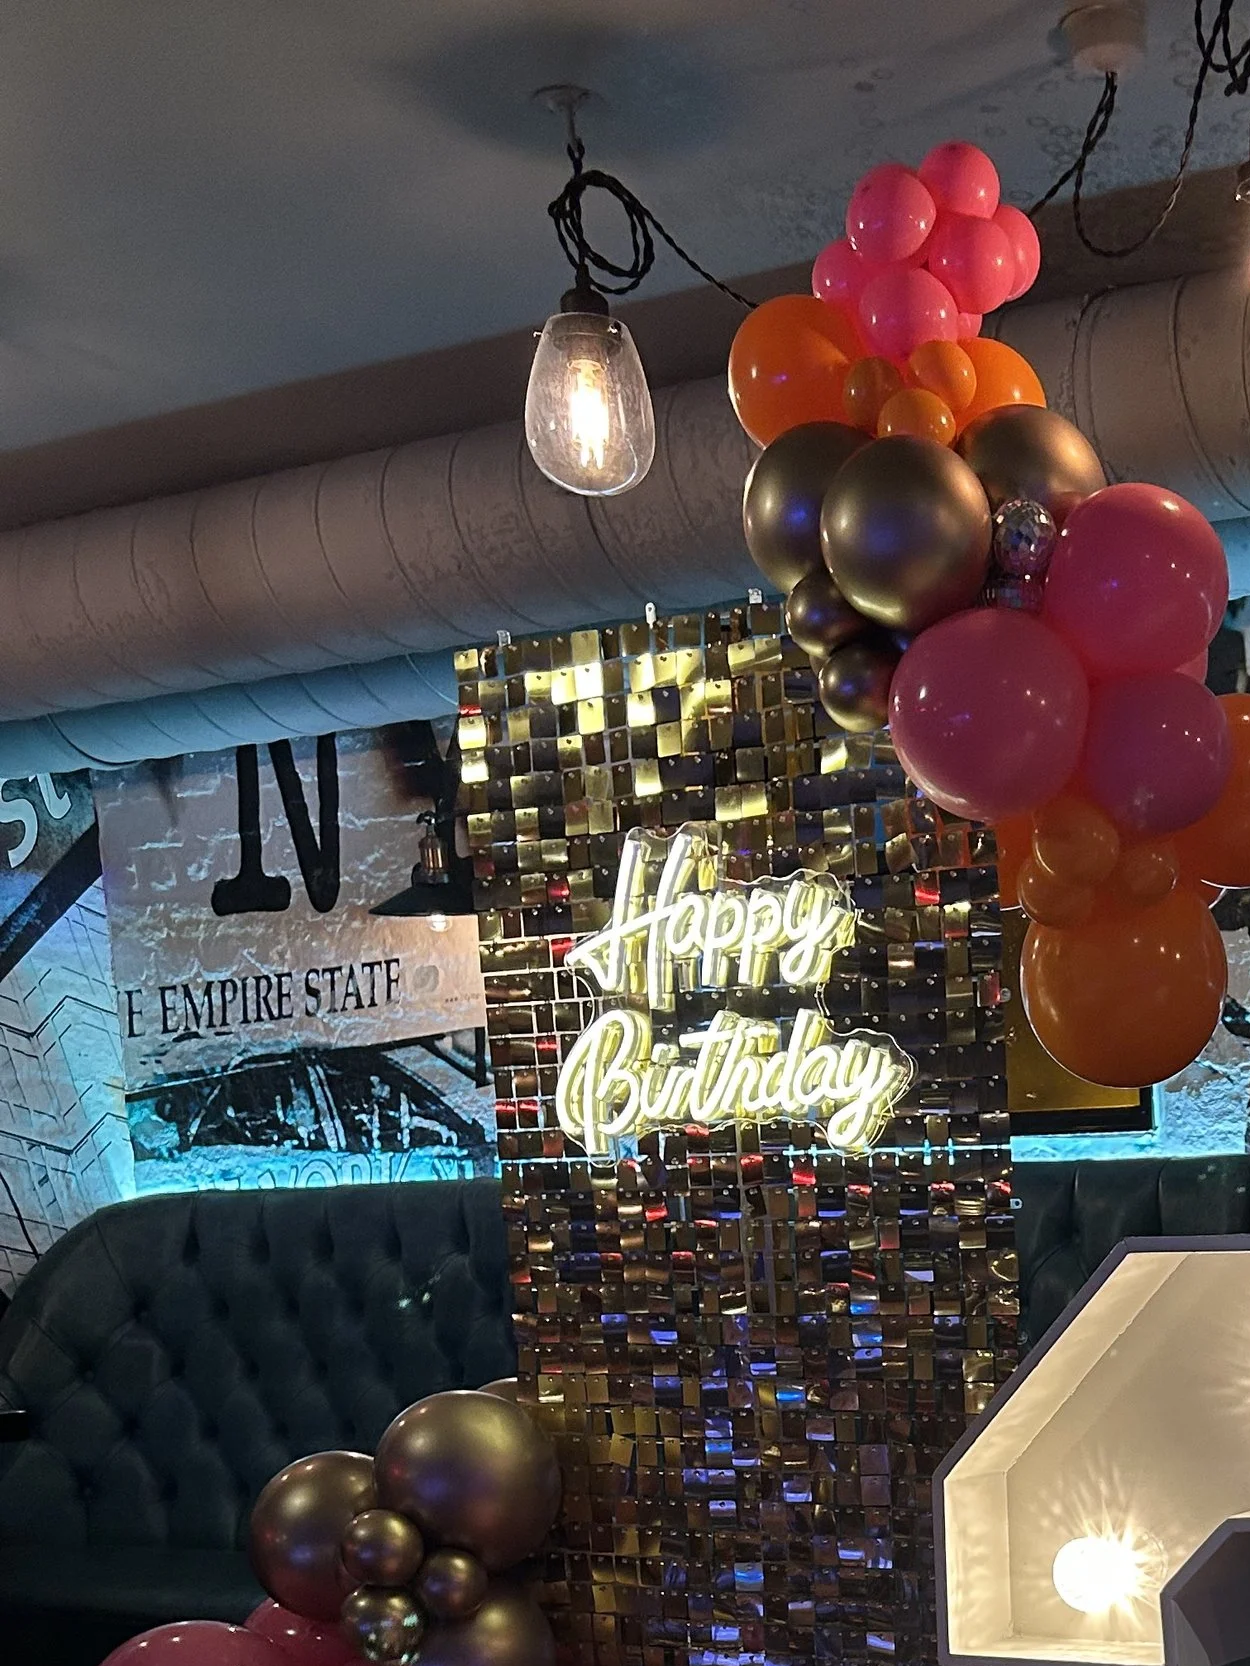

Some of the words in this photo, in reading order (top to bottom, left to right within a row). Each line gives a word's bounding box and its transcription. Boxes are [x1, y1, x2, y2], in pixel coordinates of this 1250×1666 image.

[158, 971, 294, 1035] EMPIRE
[304, 957, 402, 1018] STATE
[566, 832, 852, 1011] Happy
[555, 1007, 905, 1156] Birthday
